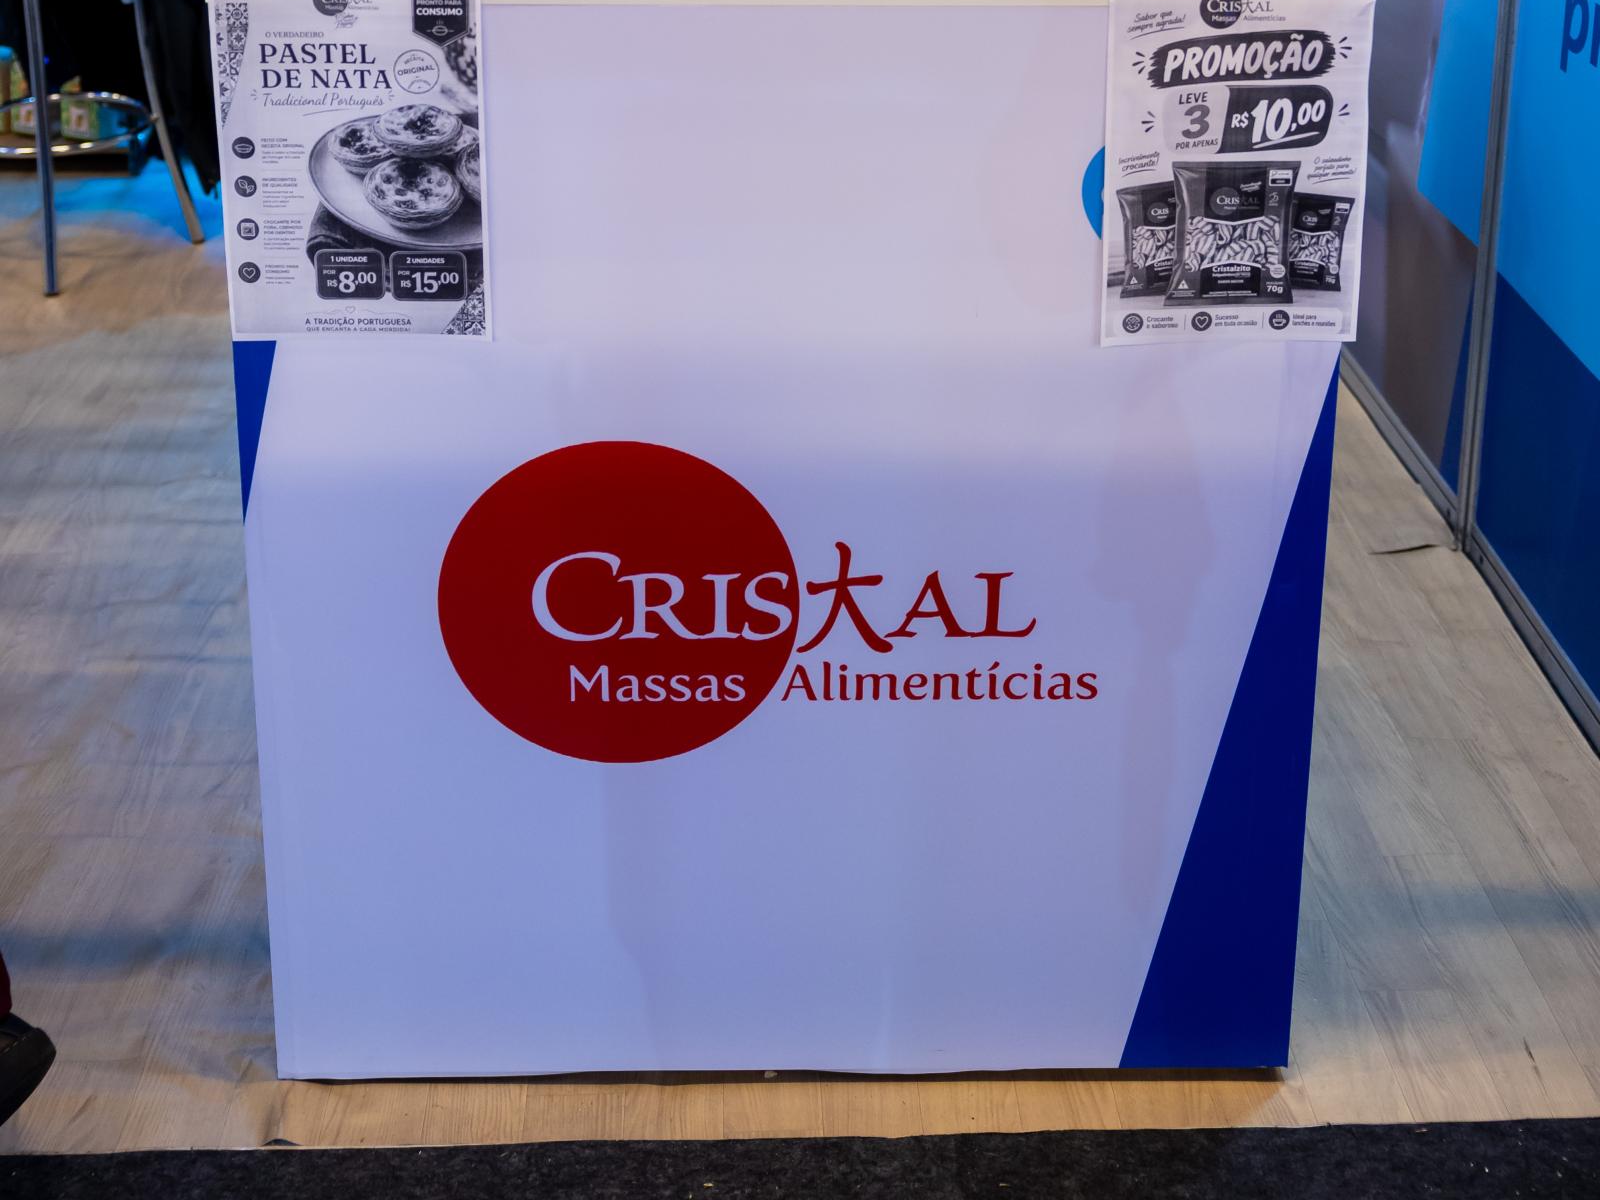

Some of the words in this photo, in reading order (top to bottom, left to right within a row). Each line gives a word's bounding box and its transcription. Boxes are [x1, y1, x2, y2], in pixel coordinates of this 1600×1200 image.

[416, 7, 463, 16] CONSUMO
[1134, 12, 1157, 23] Sabor
[1159, 10, 1173, 20] que
[1211, 14, 1237, 22] Massas
[1243, 14, 1286, 22] Alimentícias
[1126, 22, 1154, 33] sempre
[1155, 14, 1187, 30] agrada!
[259, 43, 376, 65] PASTEL
[1163, 33, 1324, 83] PROMOÇÃO
[397, 64, 436, 76] ORIGINAL
[261, 68, 302, 89] DE
[310, 68, 392, 89] NATA
[262, 92, 328, 107] Tradicional
[330, 92, 384, 110] Português
[1178, 91, 1208, 105] LEVE
[1181, 104, 1211, 140] 3
[1231, 111, 1249, 129] R$
[1250, 97, 1326, 144] 10,00
[1175, 140, 1190, 150] POR
[1191, 138, 1219, 148] APENAS
[1121, 157, 1160, 172] crocante!
[1313, 157, 1320, 165] O
[1212, 265, 1251, 273] Cristalzito
[327, 279, 338, 288] R$
[338, 271, 377, 293] 8,00
[400, 280, 411, 288] R$
[412, 271, 460, 293] 15,00
[1266, 285, 1284, 294] 70g
[314, 317, 355, 326] TRADIÇÃO
[531, 540, 1037, 654] CRISTAL
[568, 664, 747, 703] Massas
[781, 660, 1099, 702] Alimentícias
